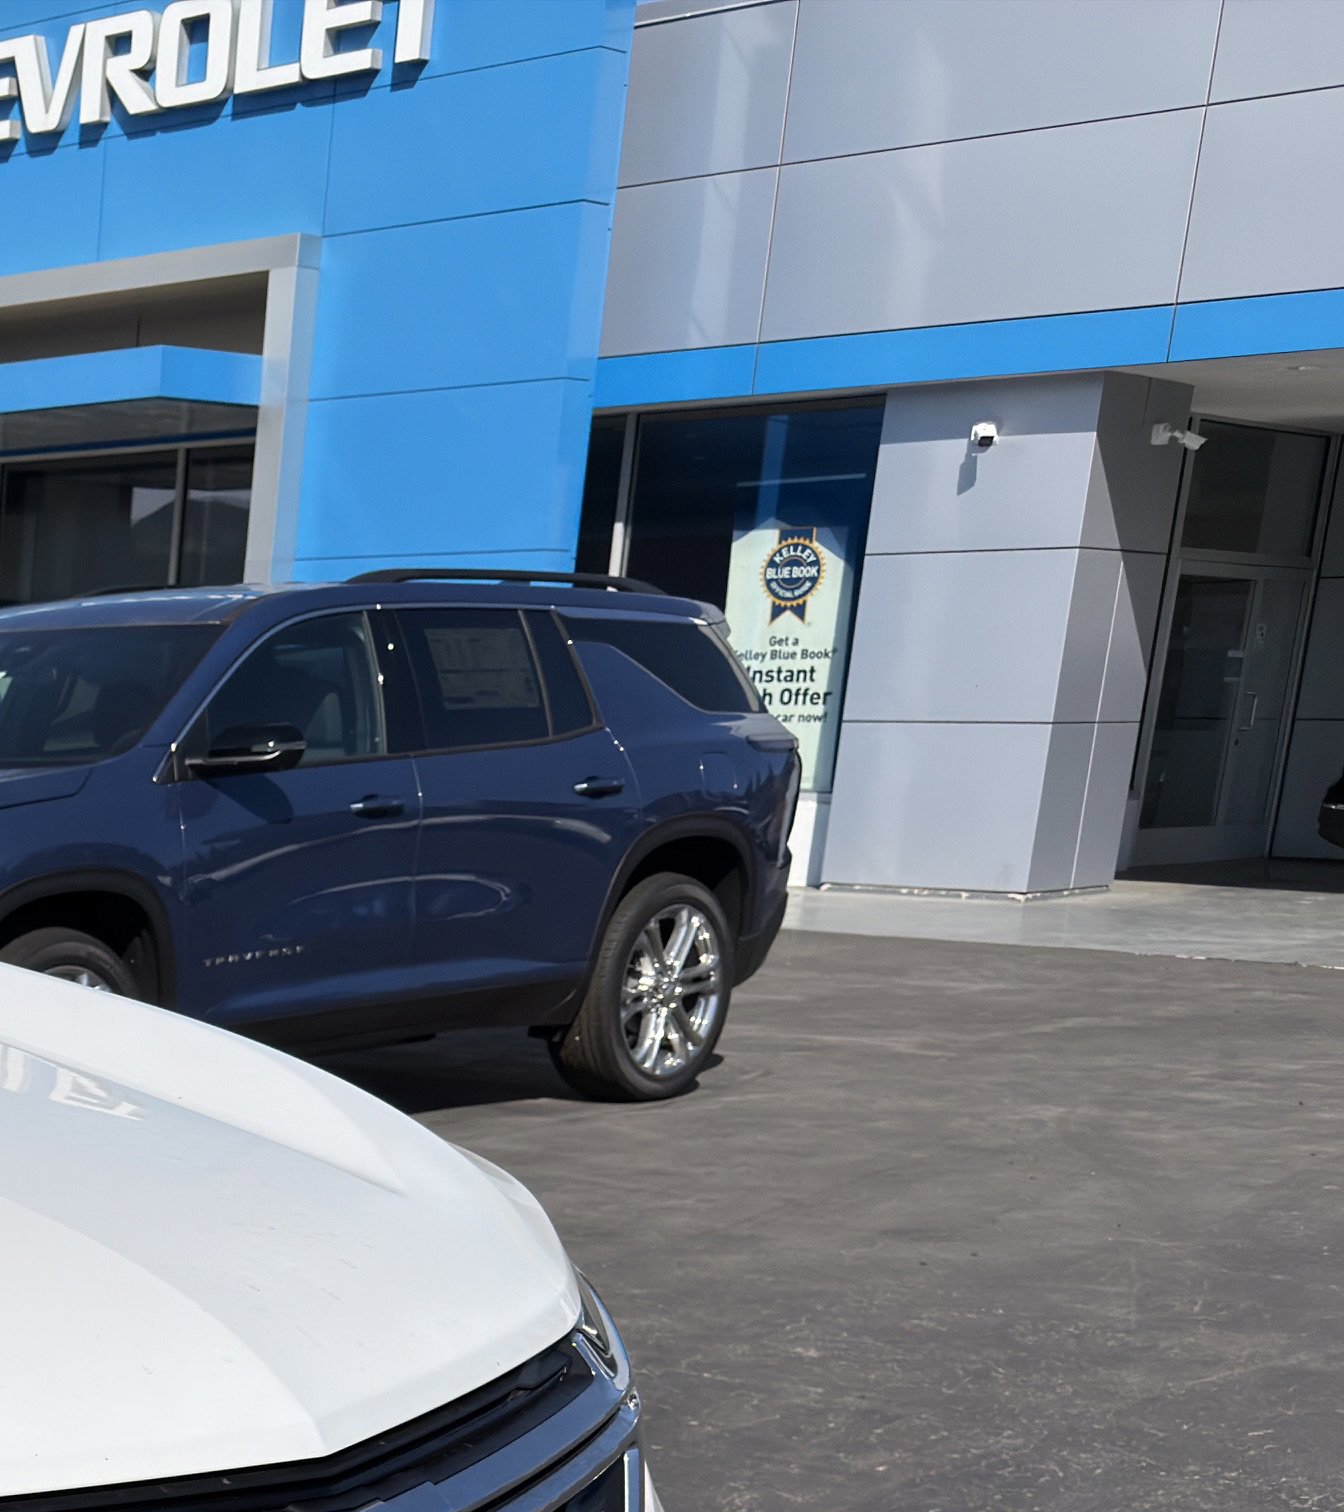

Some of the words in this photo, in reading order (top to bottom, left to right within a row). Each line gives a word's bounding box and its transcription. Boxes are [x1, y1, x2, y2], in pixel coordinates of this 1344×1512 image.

[773, 544, 816, 564] KELLEY
[765, 567, 791, 579] BLUE
[792, 565, 819, 578] BOOK
[769, 636, 789, 646] Get
[792, 638, 799, 646] a
[770, 649, 797, 660] Blue
[780, 688, 833, 705] Offer
[798, 711, 827, 723] now!
